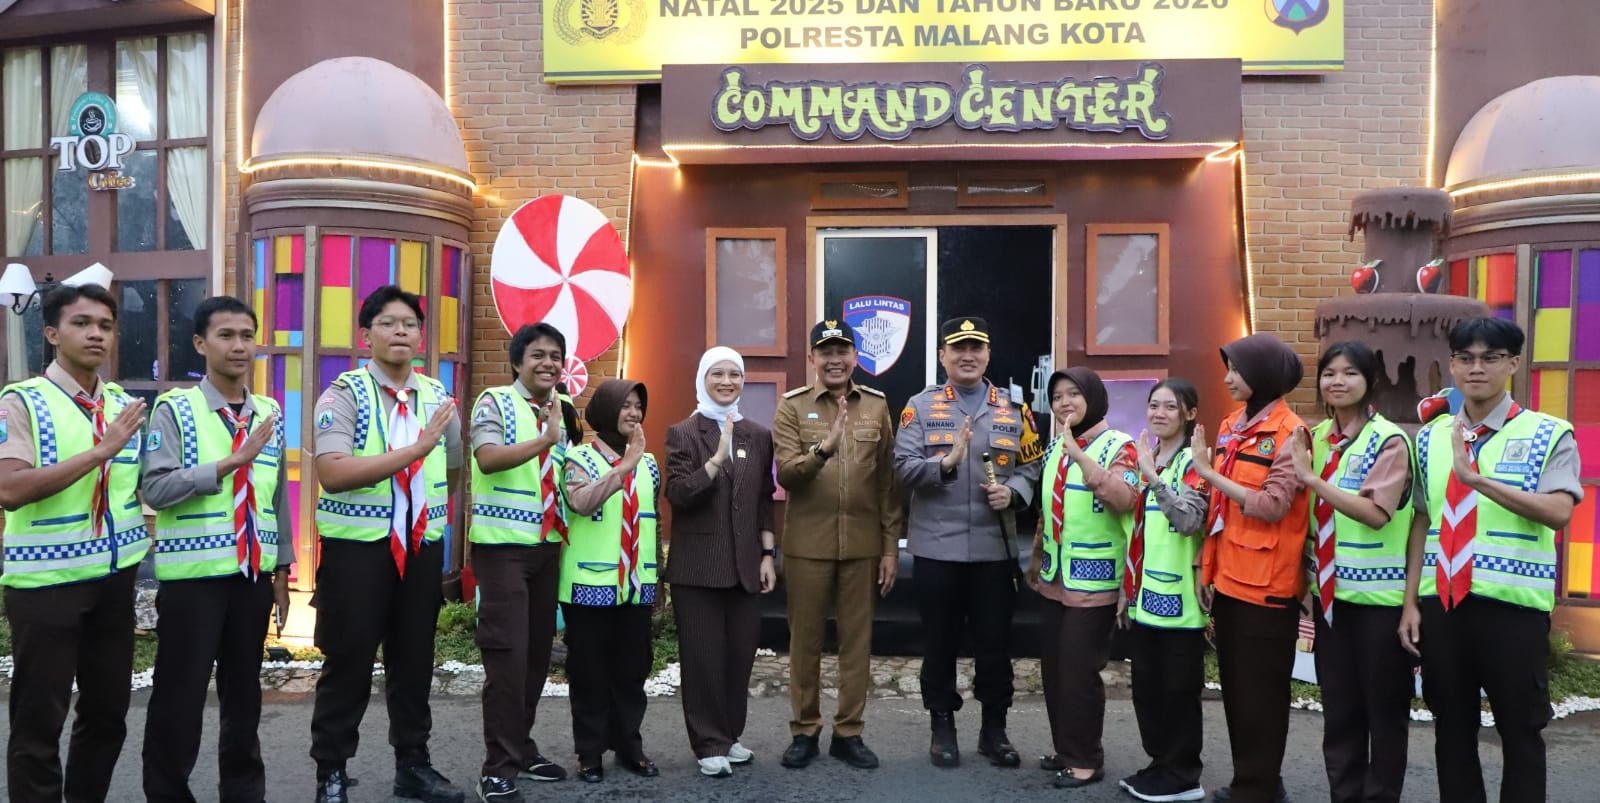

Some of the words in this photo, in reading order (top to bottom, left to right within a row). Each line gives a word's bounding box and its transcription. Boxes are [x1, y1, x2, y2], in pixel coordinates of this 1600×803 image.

[659, 0, 760, 17] NATAL
[770, 0, 844, 15] 2025
[856, 0, 920, 14] DAN
[740, 26, 904, 49] POLRESTA
[914, 23, 1049, 47] MALANG
[1060, 22, 1146, 45] KOTA
[717, 71, 951, 134] COMMAND
[959, 68, 1167, 133] CENTER
[50, 133, 133, 170] TOP
[849, 299, 871, 310] LALU
[873, 299, 905, 310] LINTAS
[992, 424, 1018, 434] POLRI
